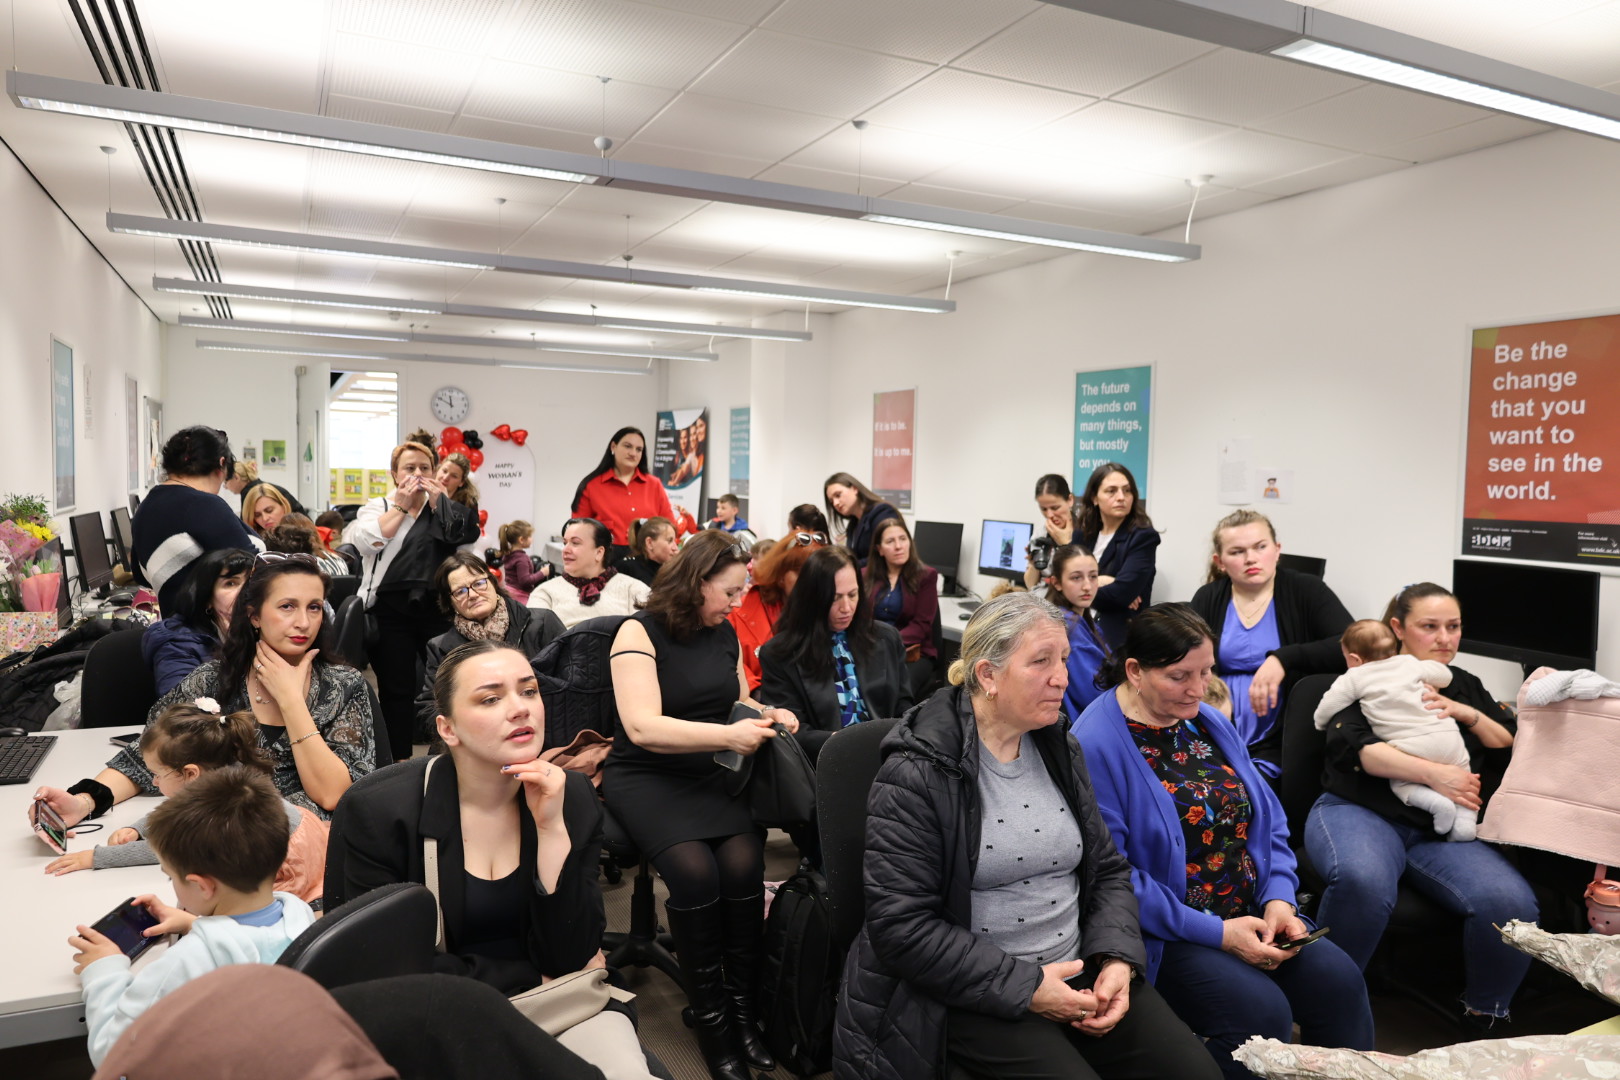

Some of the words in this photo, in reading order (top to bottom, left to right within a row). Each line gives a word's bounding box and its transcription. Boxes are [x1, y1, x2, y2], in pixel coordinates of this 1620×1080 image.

[1494, 344, 1523, 364] Be
[1530, 341, 1568, 361] the
[1081, 384, 1099, 396] The
[1101, 382, 1130, 395] future
[1492, 371, 1577, 393] change
[1081, 401, 1121, 416] depends
[1123, 401, 1137, 412] on
[1490, 398, 1534, 418] that
[1540, 399, 1586, 421] you
[1080, 421, 1105, 434] many
[1107, 419, 1142, 433] things,
[1489, 426, 1543, 445] want
[1550, 425, 1575, 444] to
[1079, 439, 1094, 451] but
[1096, 438, 1129, 453] mostly
[1079, 458, 1090, 469] on
[1487, 457, 1527, 473] see
[1533, 453, 1555, 473] in
[1562, 452, 1603, 473] the
[488, 471, 522, 479] WOMAN'S
[1487, 481, 1557, 501] world.
